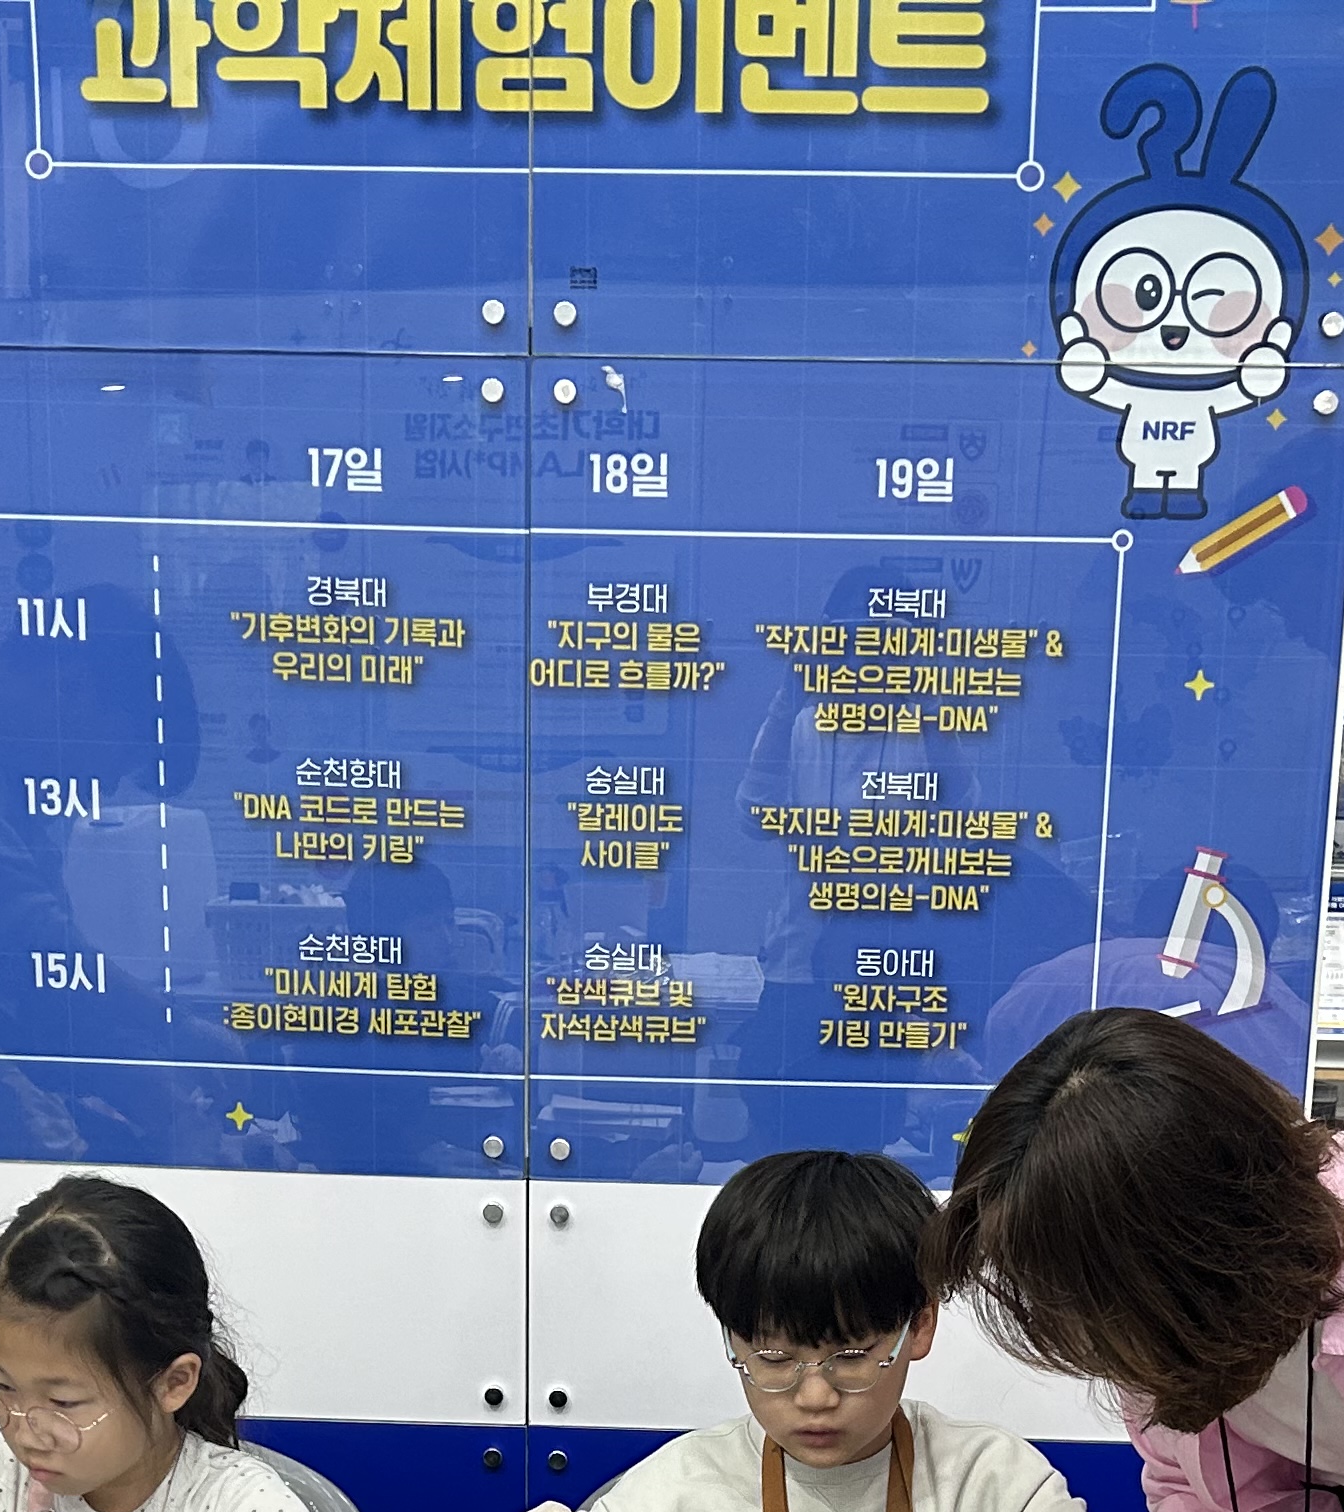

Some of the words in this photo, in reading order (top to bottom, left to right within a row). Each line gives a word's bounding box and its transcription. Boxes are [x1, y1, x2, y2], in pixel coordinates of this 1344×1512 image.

[80, 0, 990, 114] 과학체험이벤트
[1142, 420, 1196, 441] NRF
[309, 448, 383, 492] 17일
[589, 452, 669, 498] 18일
[876, 457, 955, 504] 19일
[307, 576, 386, 608] 경북대
[587, 583, 668, 613] 부경대
[868, 588, 947, 619] 전북대
[18, 598, 87, 640] 11시
[231, 612, 374, 646] "기후변화의
[385, 615, 465, 648] 기록과
[548, 620, 638, 653] "지구의
[647, 622, 700, 652] 물은
[756, 624, 847, 657] "작지만
[855, 626, 1038, 659] 큰세계:미생물"
[1047, 631, 1063, 658] &
[273, 654, 352, 683] 우리의
[362, 657, 423, 684] 미래"
[530, 659, 609, 689] 어디로
[618, 661, 726, 692] 흐를까?"
[794, 664, 1021, 698] "내손으로꺼내보는
[814, 703, 998, 734] 생명의실-DNA"
[296, 757, 400, 789] 순천향대
[585, 766, 664, 795] 숭실대
[861, 770, 938, 801] 전북대
[25, 778, 100, 820] 13시
[234, 792, 292, 821] "DNA
[300, 794, 377, 825] 코드로
[386, 798, 465, 828] 만드는
[567, 802, 683, 833] "칼레이도
[750, 806, 841, 836] "작지만
[848, 809, 1029, 838] 큰세계:미생물"
[1035, 813, 1053, 838] &
[276, 831, 354, 862] 나만의
[363, 835, 424, 864] 키링"
[581, 841, 669, 870] 사이클"
[788, 844, 1012, 877] "내손으로꺼내보는
[809, 883, 989, 912] 생명의실-DNA"
[298, 934, 401, 965] 순천향대
[584, 943, 662, 971] 숭실대
[856, 948, 934, 978] 동아대
[32, 952, 105, 993] 15시
[264, 968, 377, 998] "미시세계
[386, 972, 437, 1000] 탐험
[546, 978, 662, 1007] "삼색큐브
[669, 981, 693, 1007] 및
[834, 983, 948, 1014] "원자구조
[223, 1002, 360, 1034] :종이현미경
[369, 1006, 480, 1039] 세포관찰"
[541, 1014, 705, 1044] 자석삼색큐브"
[820, 1020, 870, 1047] 키링
[879, 1021, 967, 1050] 만들기"
